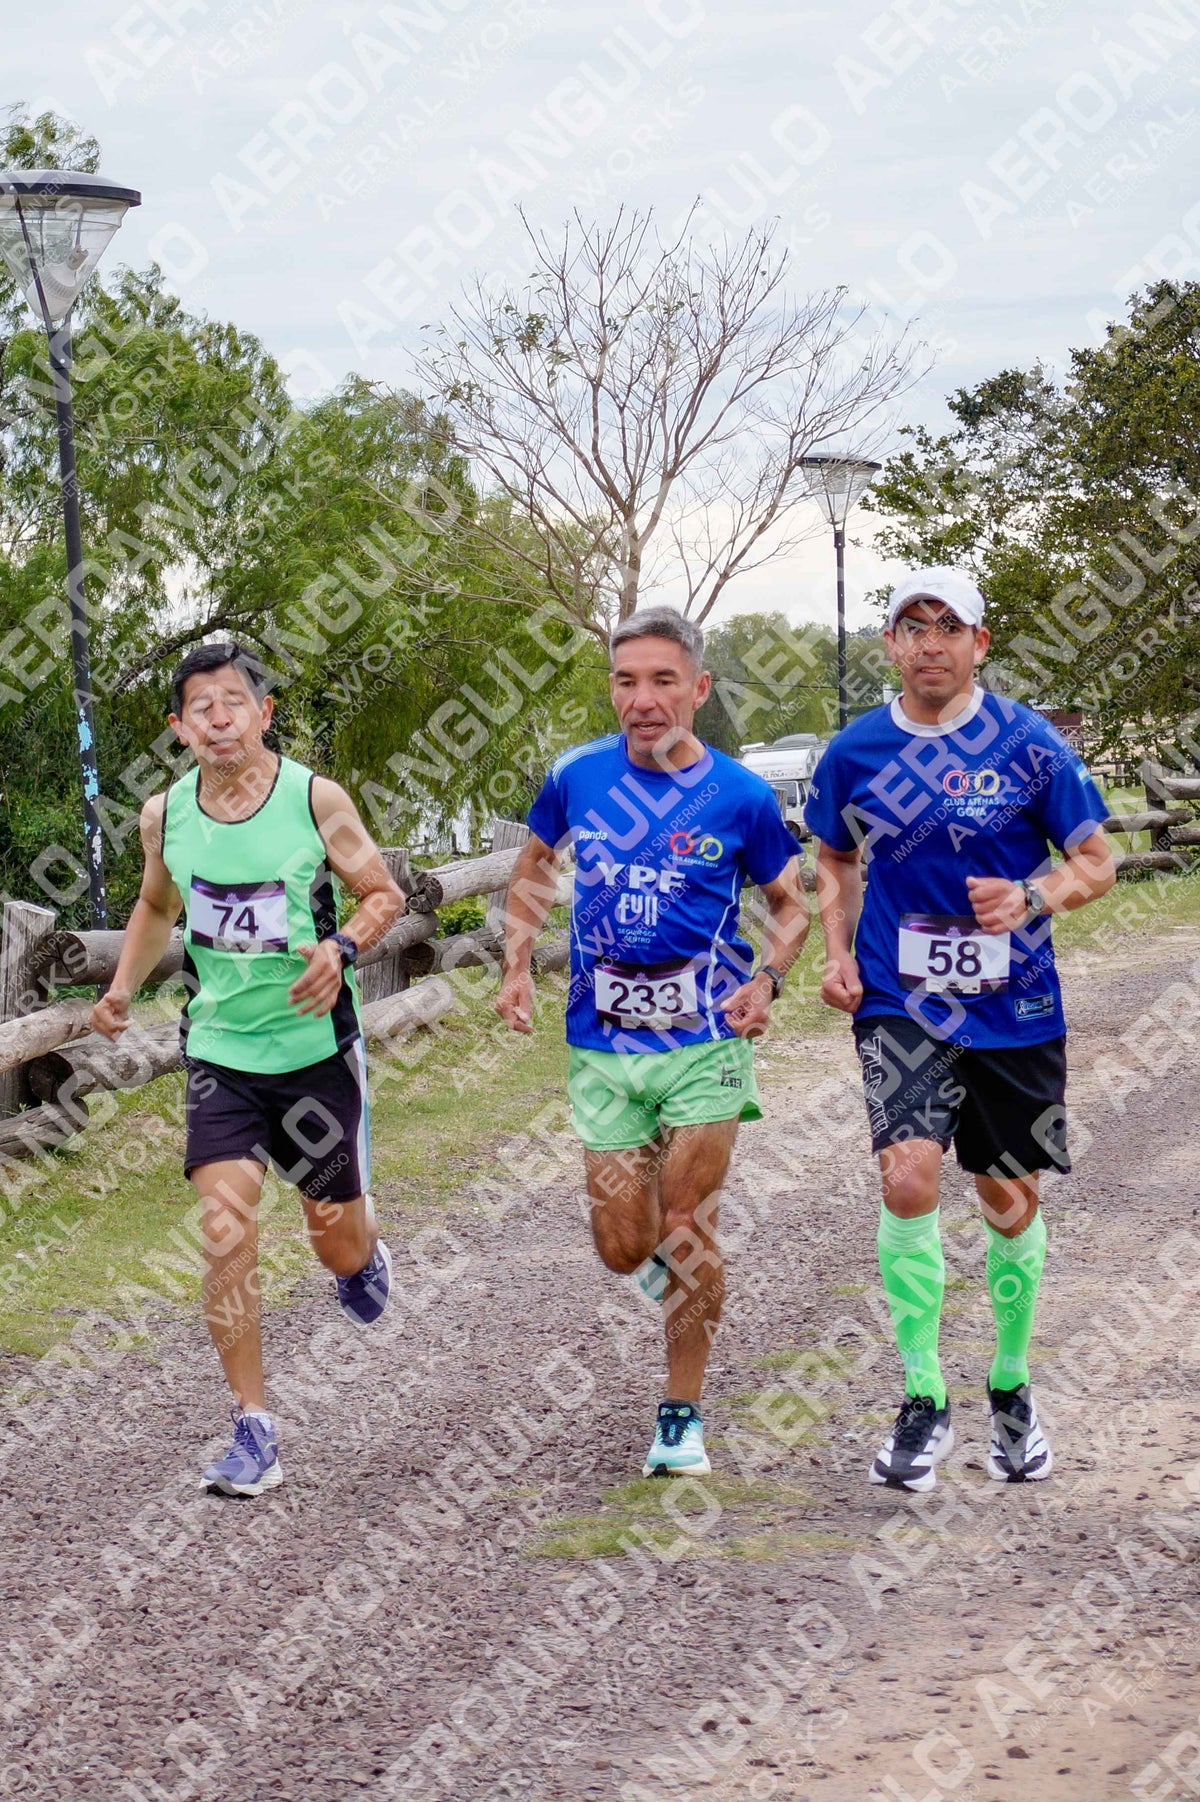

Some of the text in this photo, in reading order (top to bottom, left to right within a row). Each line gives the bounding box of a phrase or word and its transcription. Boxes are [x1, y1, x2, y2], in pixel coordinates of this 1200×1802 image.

[943, 796, 1001, 807] CLUB ATENAS
[956, 806, 987, 817] GOYA
[579, 829, 608, 841] panda
[597, 862, 686, 894] YPF
[212, 903, 259, 939] 74
[927, 940, 982, 977] 58
[609, 981, 683, 1016] 233
